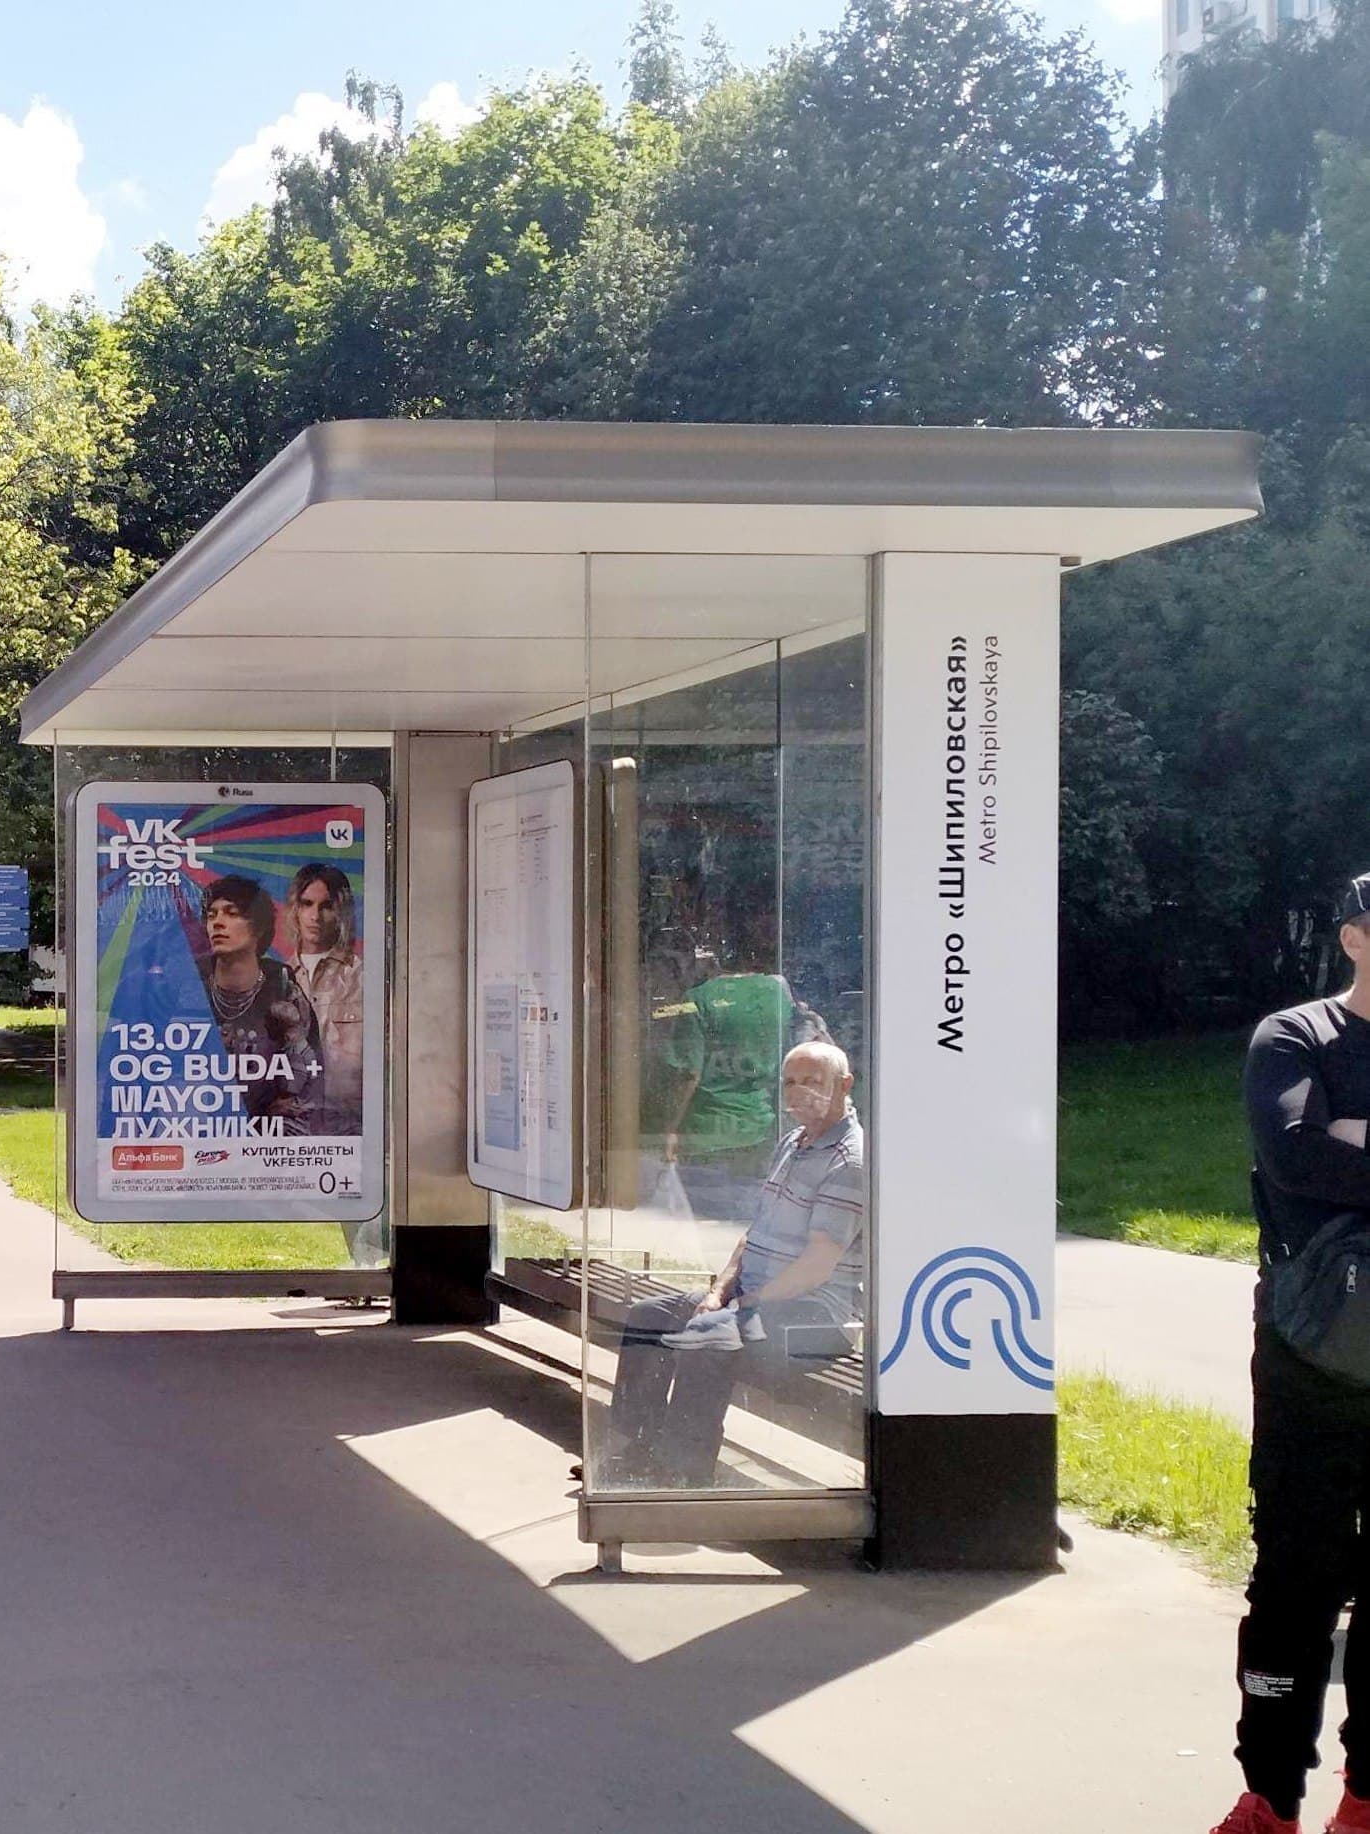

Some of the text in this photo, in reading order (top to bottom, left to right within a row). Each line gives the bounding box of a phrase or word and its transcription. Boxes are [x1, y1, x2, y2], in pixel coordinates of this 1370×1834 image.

[978, 634, 1003, 865] Metro Shipilovskaya
[125, 818, 181, 844] VK
[937, 634, 970, 1053] Метро «Шипиловская»
[98, 836, 213, 870] fest
[127, 871, 180, 887] 2024
[111, 1022, 211, 1052] 13.07
[109, 1053, 172, 1082] OG
[183, 1053, 294, 1082] BUDA
[110, 1084, 248, 1113] MAYOT
[112, 1115, 285, 1139] ЛУЖНИКИ
[118, 1152, 178, 1165] Альфа Банк
[241, 1146, 355, 1157] КУПИТЬ БИЛЕТЫ
[263, 1157, 334, 1168] VKFEST.RU
[318, 1171, 354, 1194] 0+
